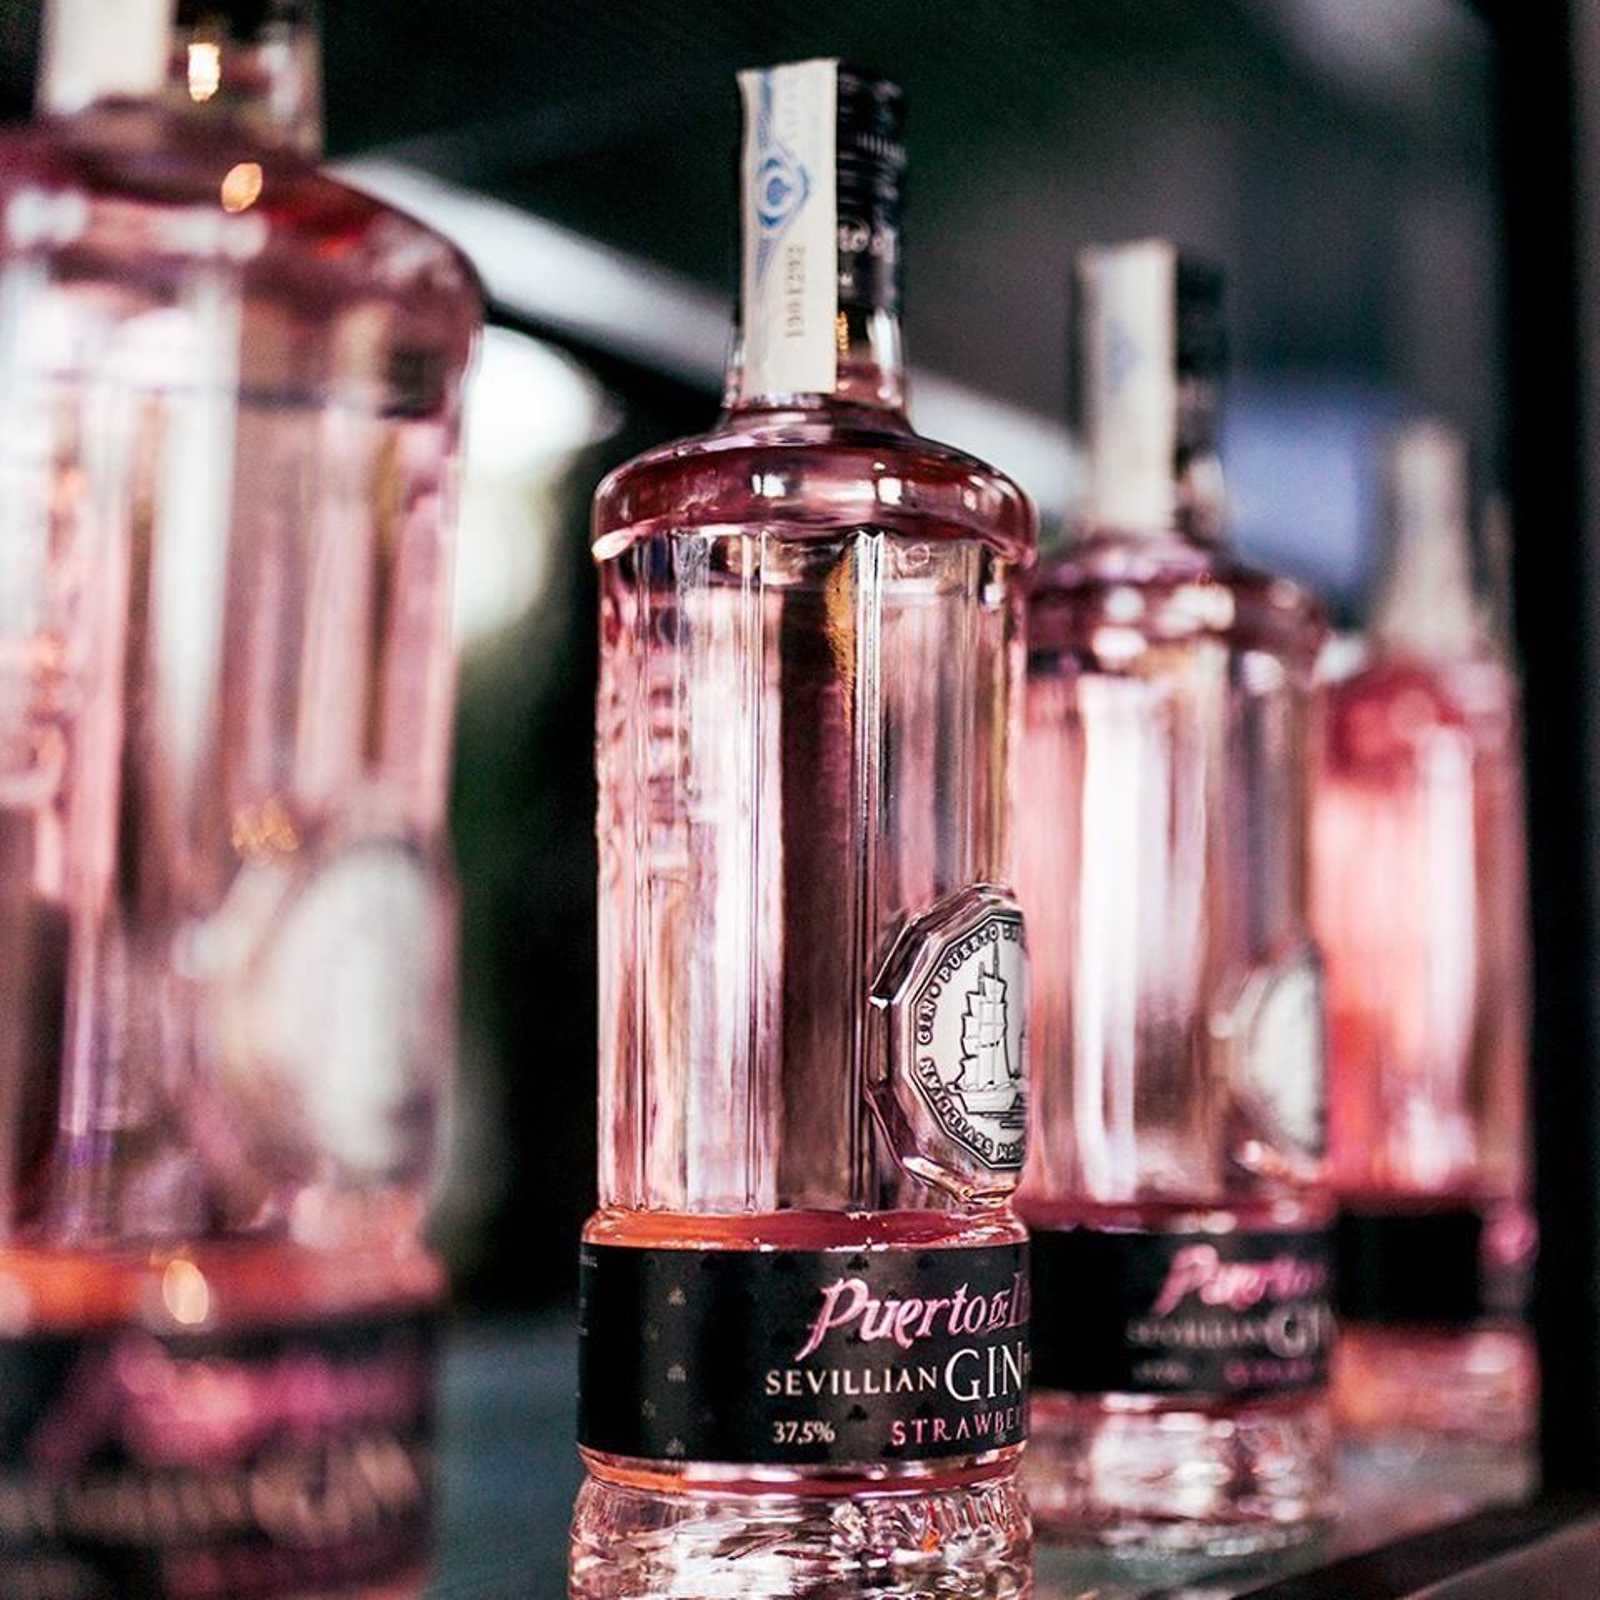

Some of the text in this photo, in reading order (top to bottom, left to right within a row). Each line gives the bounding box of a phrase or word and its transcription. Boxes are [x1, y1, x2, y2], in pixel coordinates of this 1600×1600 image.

[938, 923, 999, 983] PUERTO
[917, 998, 938, 1045] GIN
[795, 1278, 985, 1362] Puerto
[765, 1367, 938, 1395] SEVILLIAN
[944, 1341, 1023, 1401] GIN
